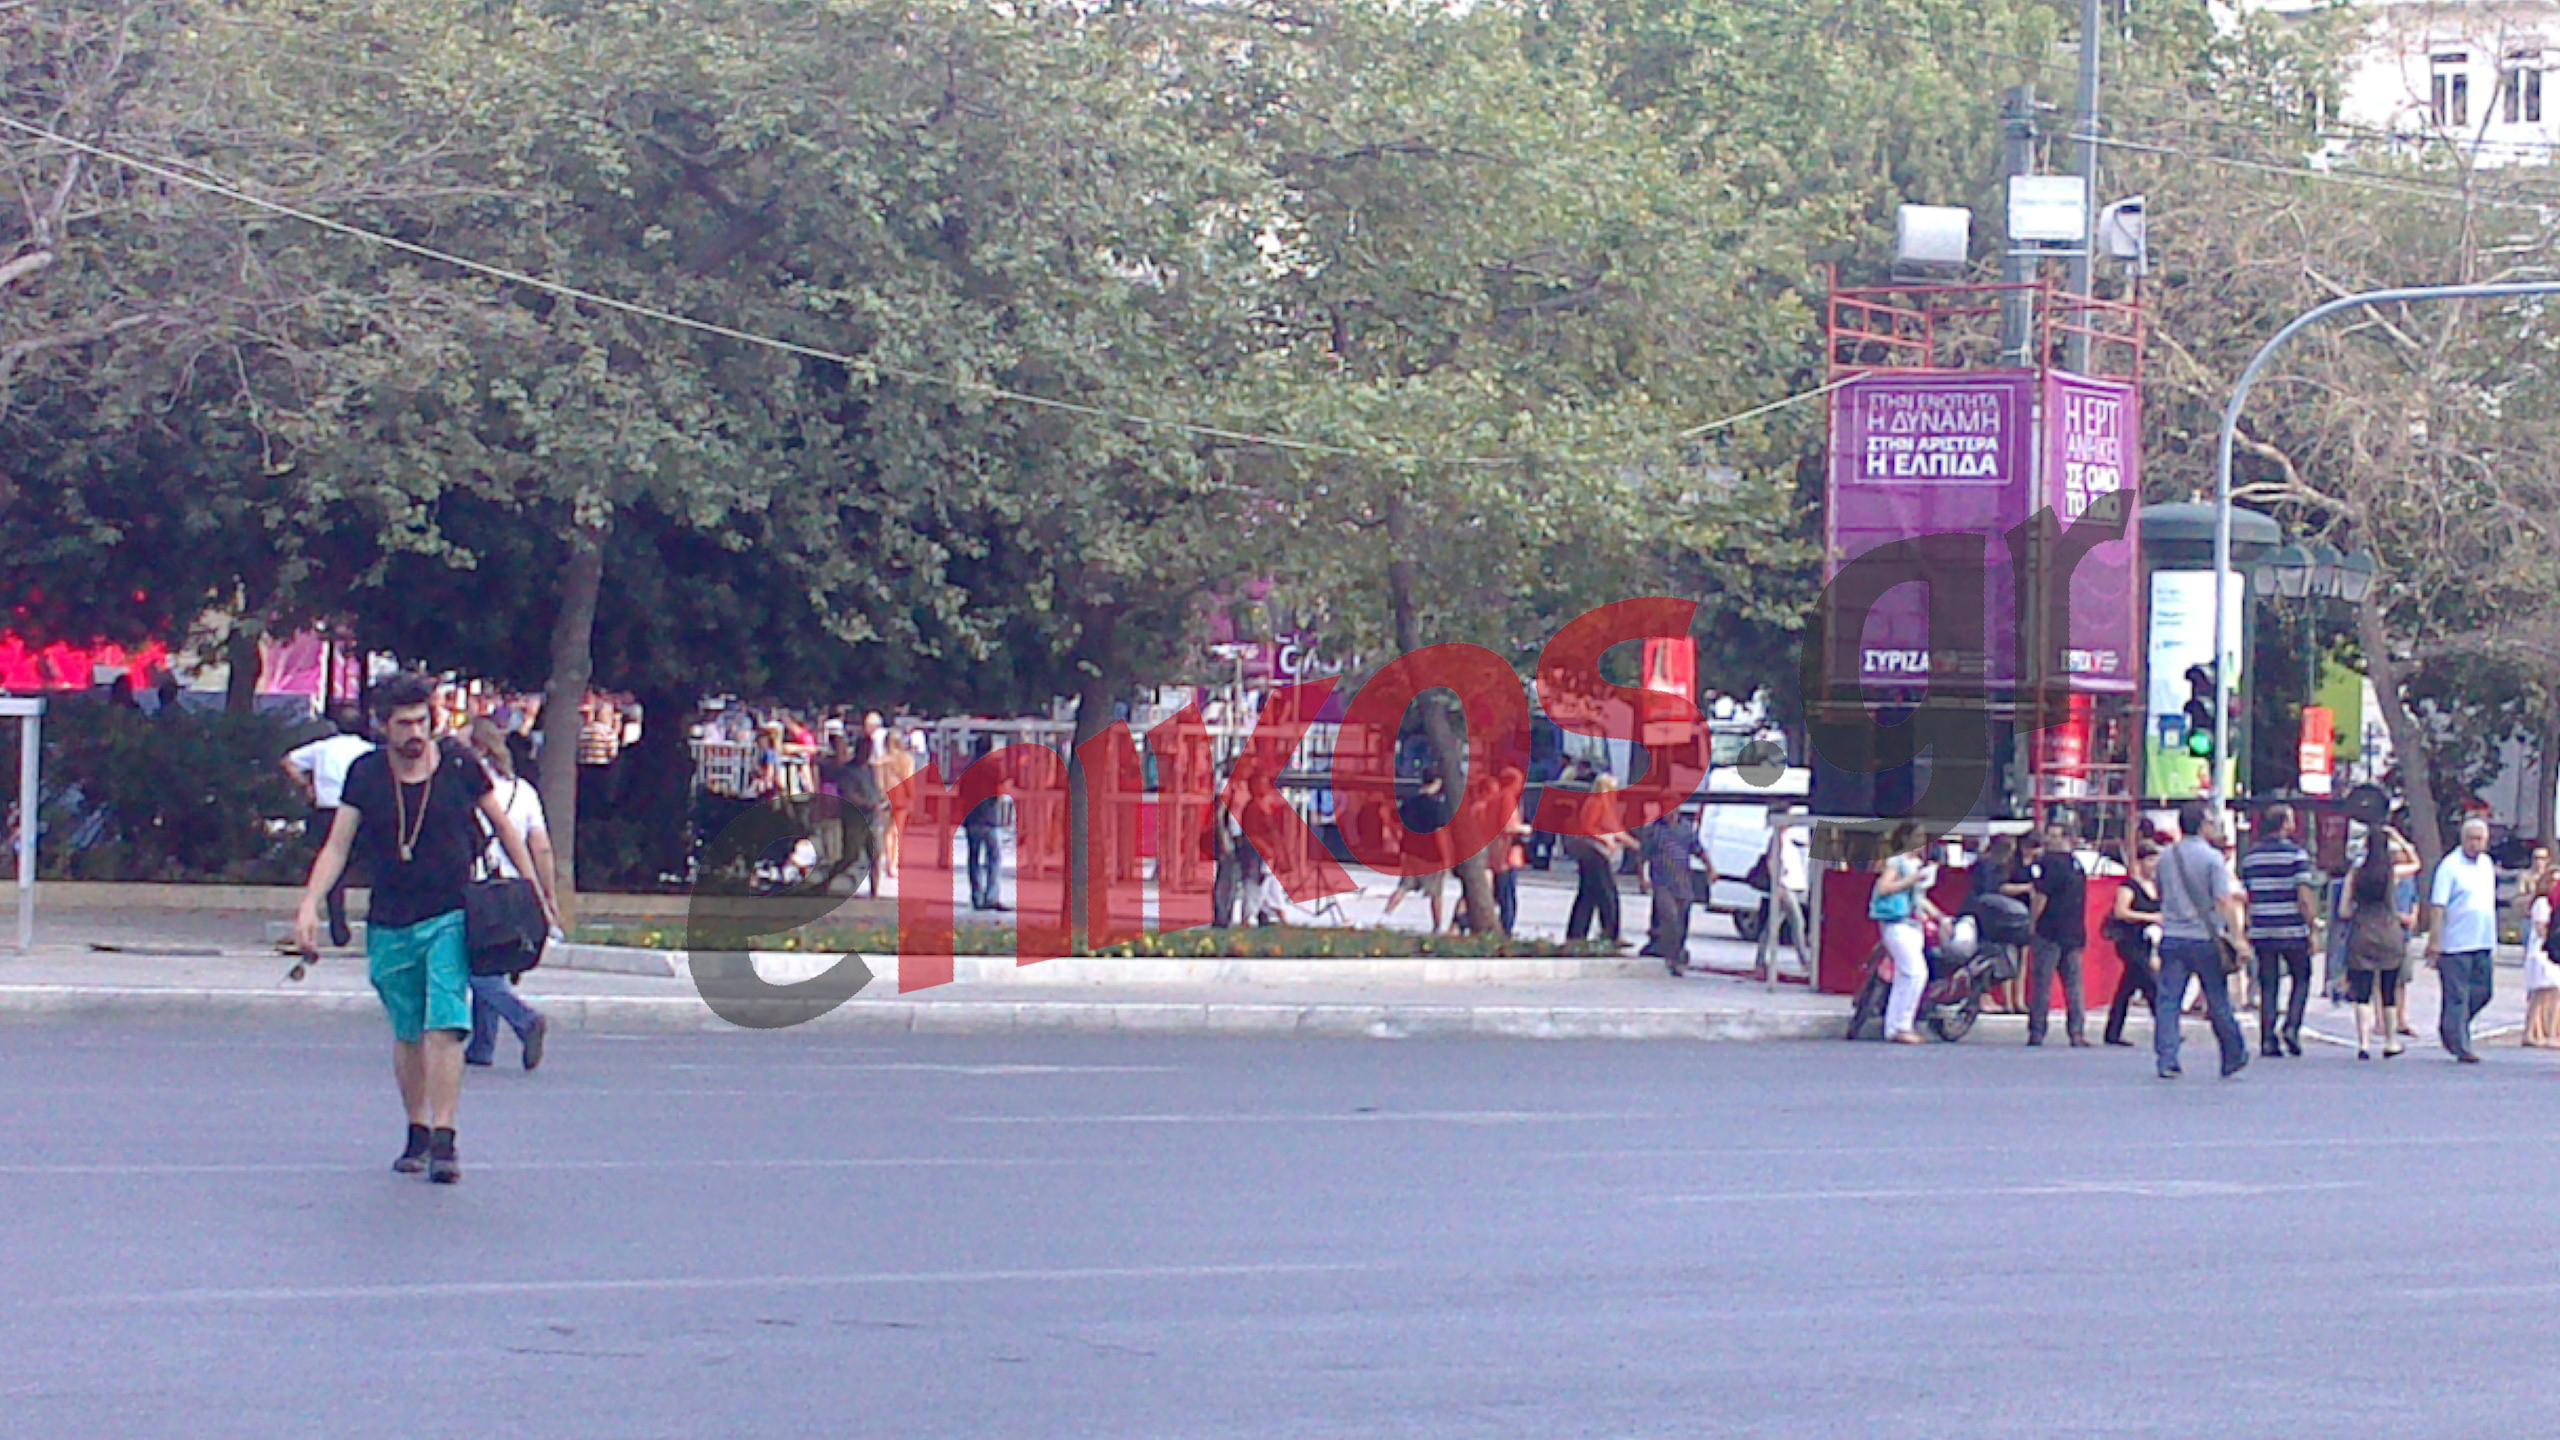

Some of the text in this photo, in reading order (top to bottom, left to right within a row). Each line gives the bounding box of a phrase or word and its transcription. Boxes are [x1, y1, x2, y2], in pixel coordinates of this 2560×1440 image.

[1867, 410, 2000, 433] Η ΔΥΝΑΜΗ
[2065, 393, 2121, 439] Η ΕΡΤ
[1867, 436, 1999, 452] ΣΤΗΝ ΑΡΙΣΤΕΡΑ
[1867, 453, 1999, 476] Η ΕΛΠΙΔΑ
[1863, 649, 1934, 673] ΣΥΡΙΖΑ
